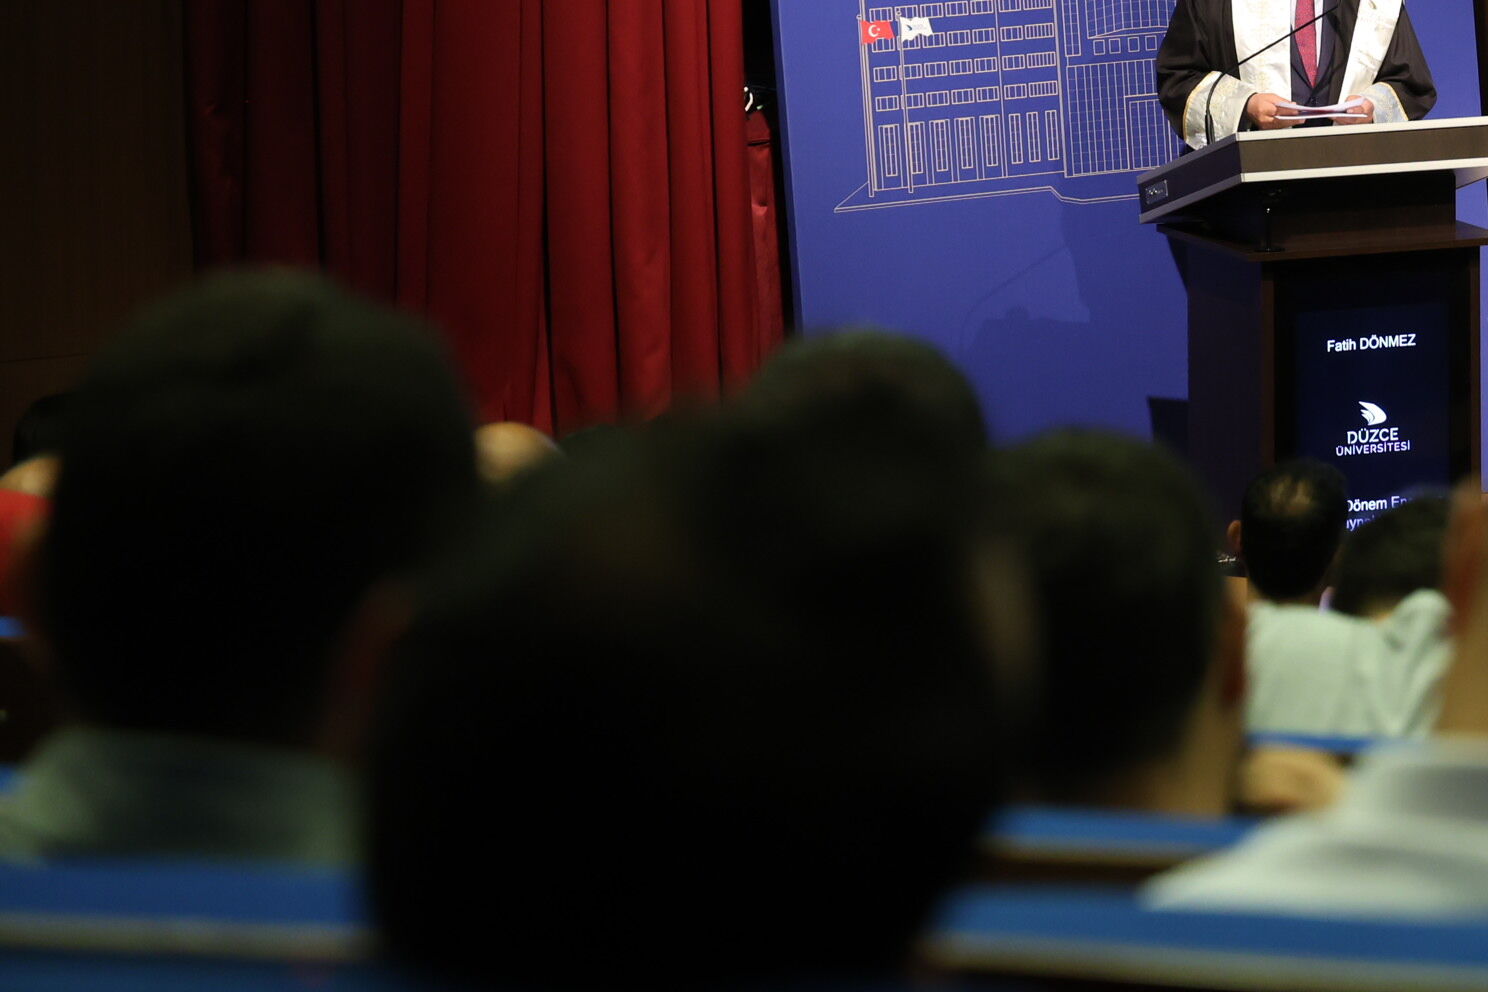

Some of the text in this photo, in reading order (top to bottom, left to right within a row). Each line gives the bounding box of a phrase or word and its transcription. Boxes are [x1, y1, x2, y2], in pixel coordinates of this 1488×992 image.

[1327, 333, 1417, 352] Fatih DÖNMEZ
[1347, 427, 1399, 444] DÜZCE
[1335, 440, 1411, 457] ÜNİVERSİTESİ
